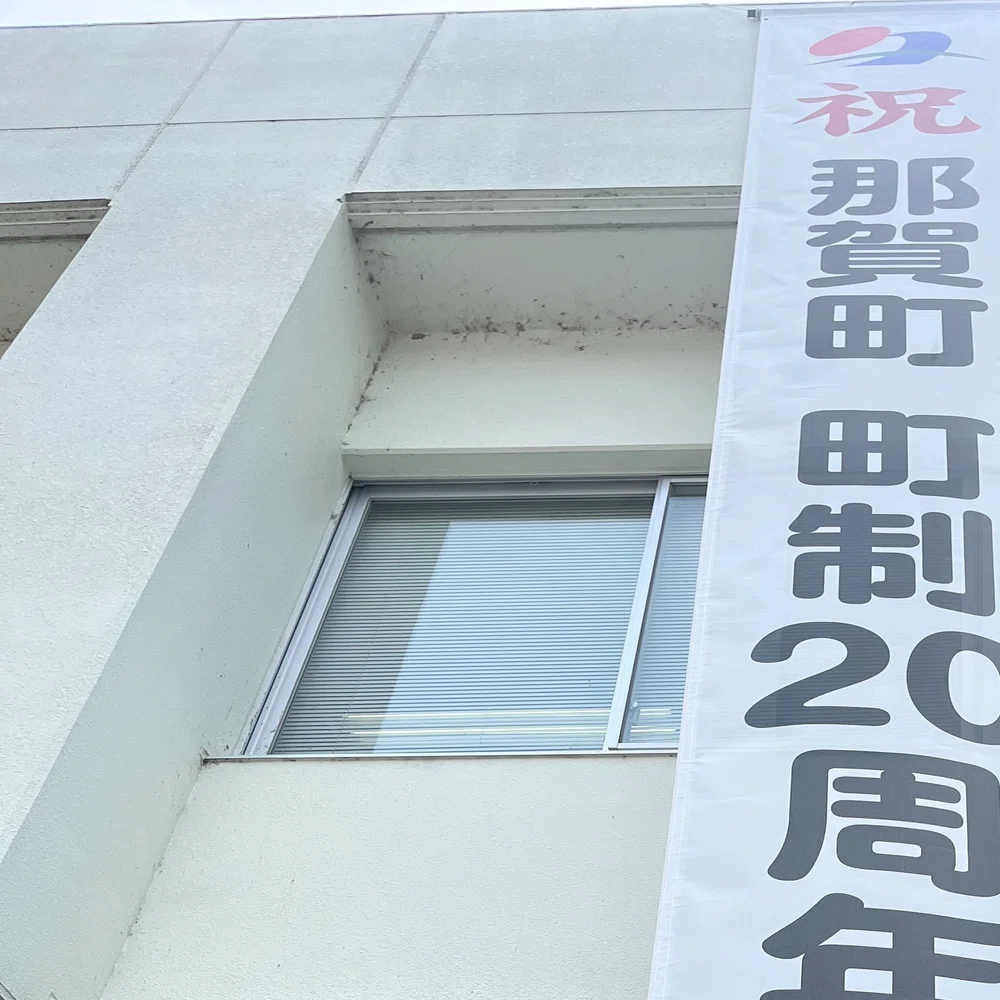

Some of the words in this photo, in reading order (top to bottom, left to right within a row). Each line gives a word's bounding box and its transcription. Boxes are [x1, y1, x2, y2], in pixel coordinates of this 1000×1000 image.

[792, 82, 982, 137] 祝
[805, 157, 989, 367] 那賀町
